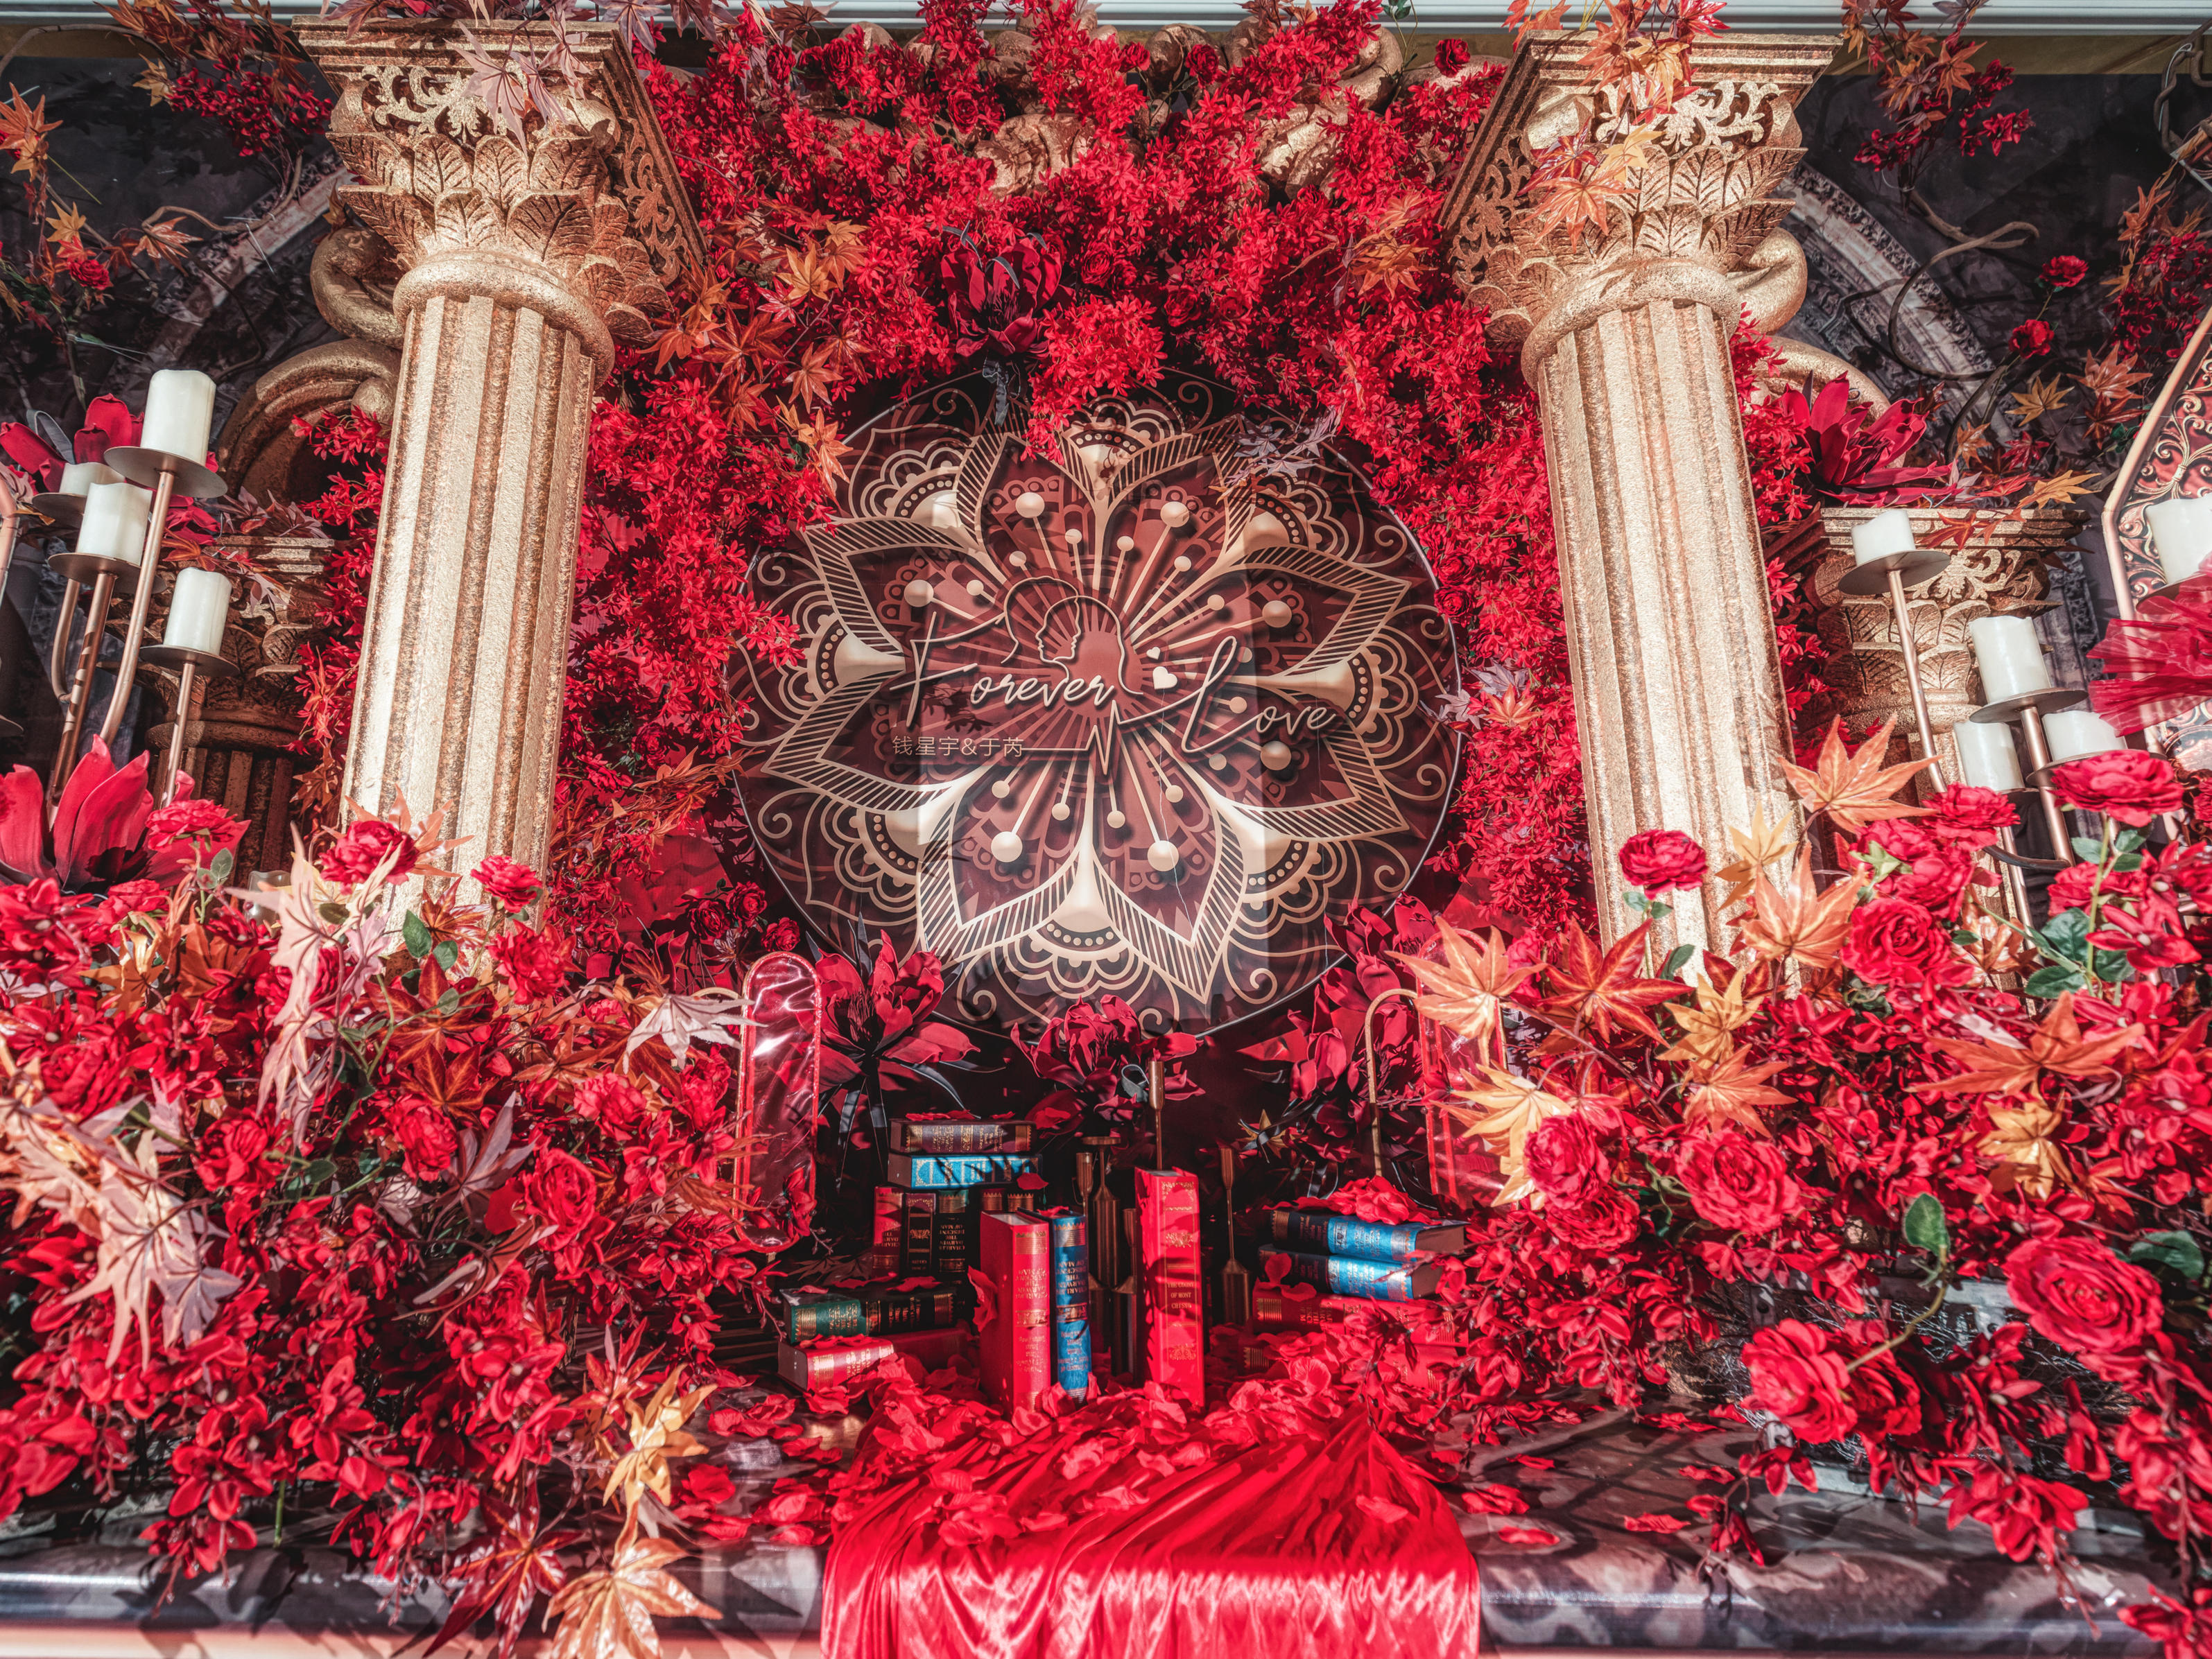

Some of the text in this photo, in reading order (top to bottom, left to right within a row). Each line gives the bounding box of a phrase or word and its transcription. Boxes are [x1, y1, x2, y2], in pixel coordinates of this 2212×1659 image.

[890, 611, 1337, 754] Forever Love
[892, 735, 1024, 758] 钱星宇&于芮
